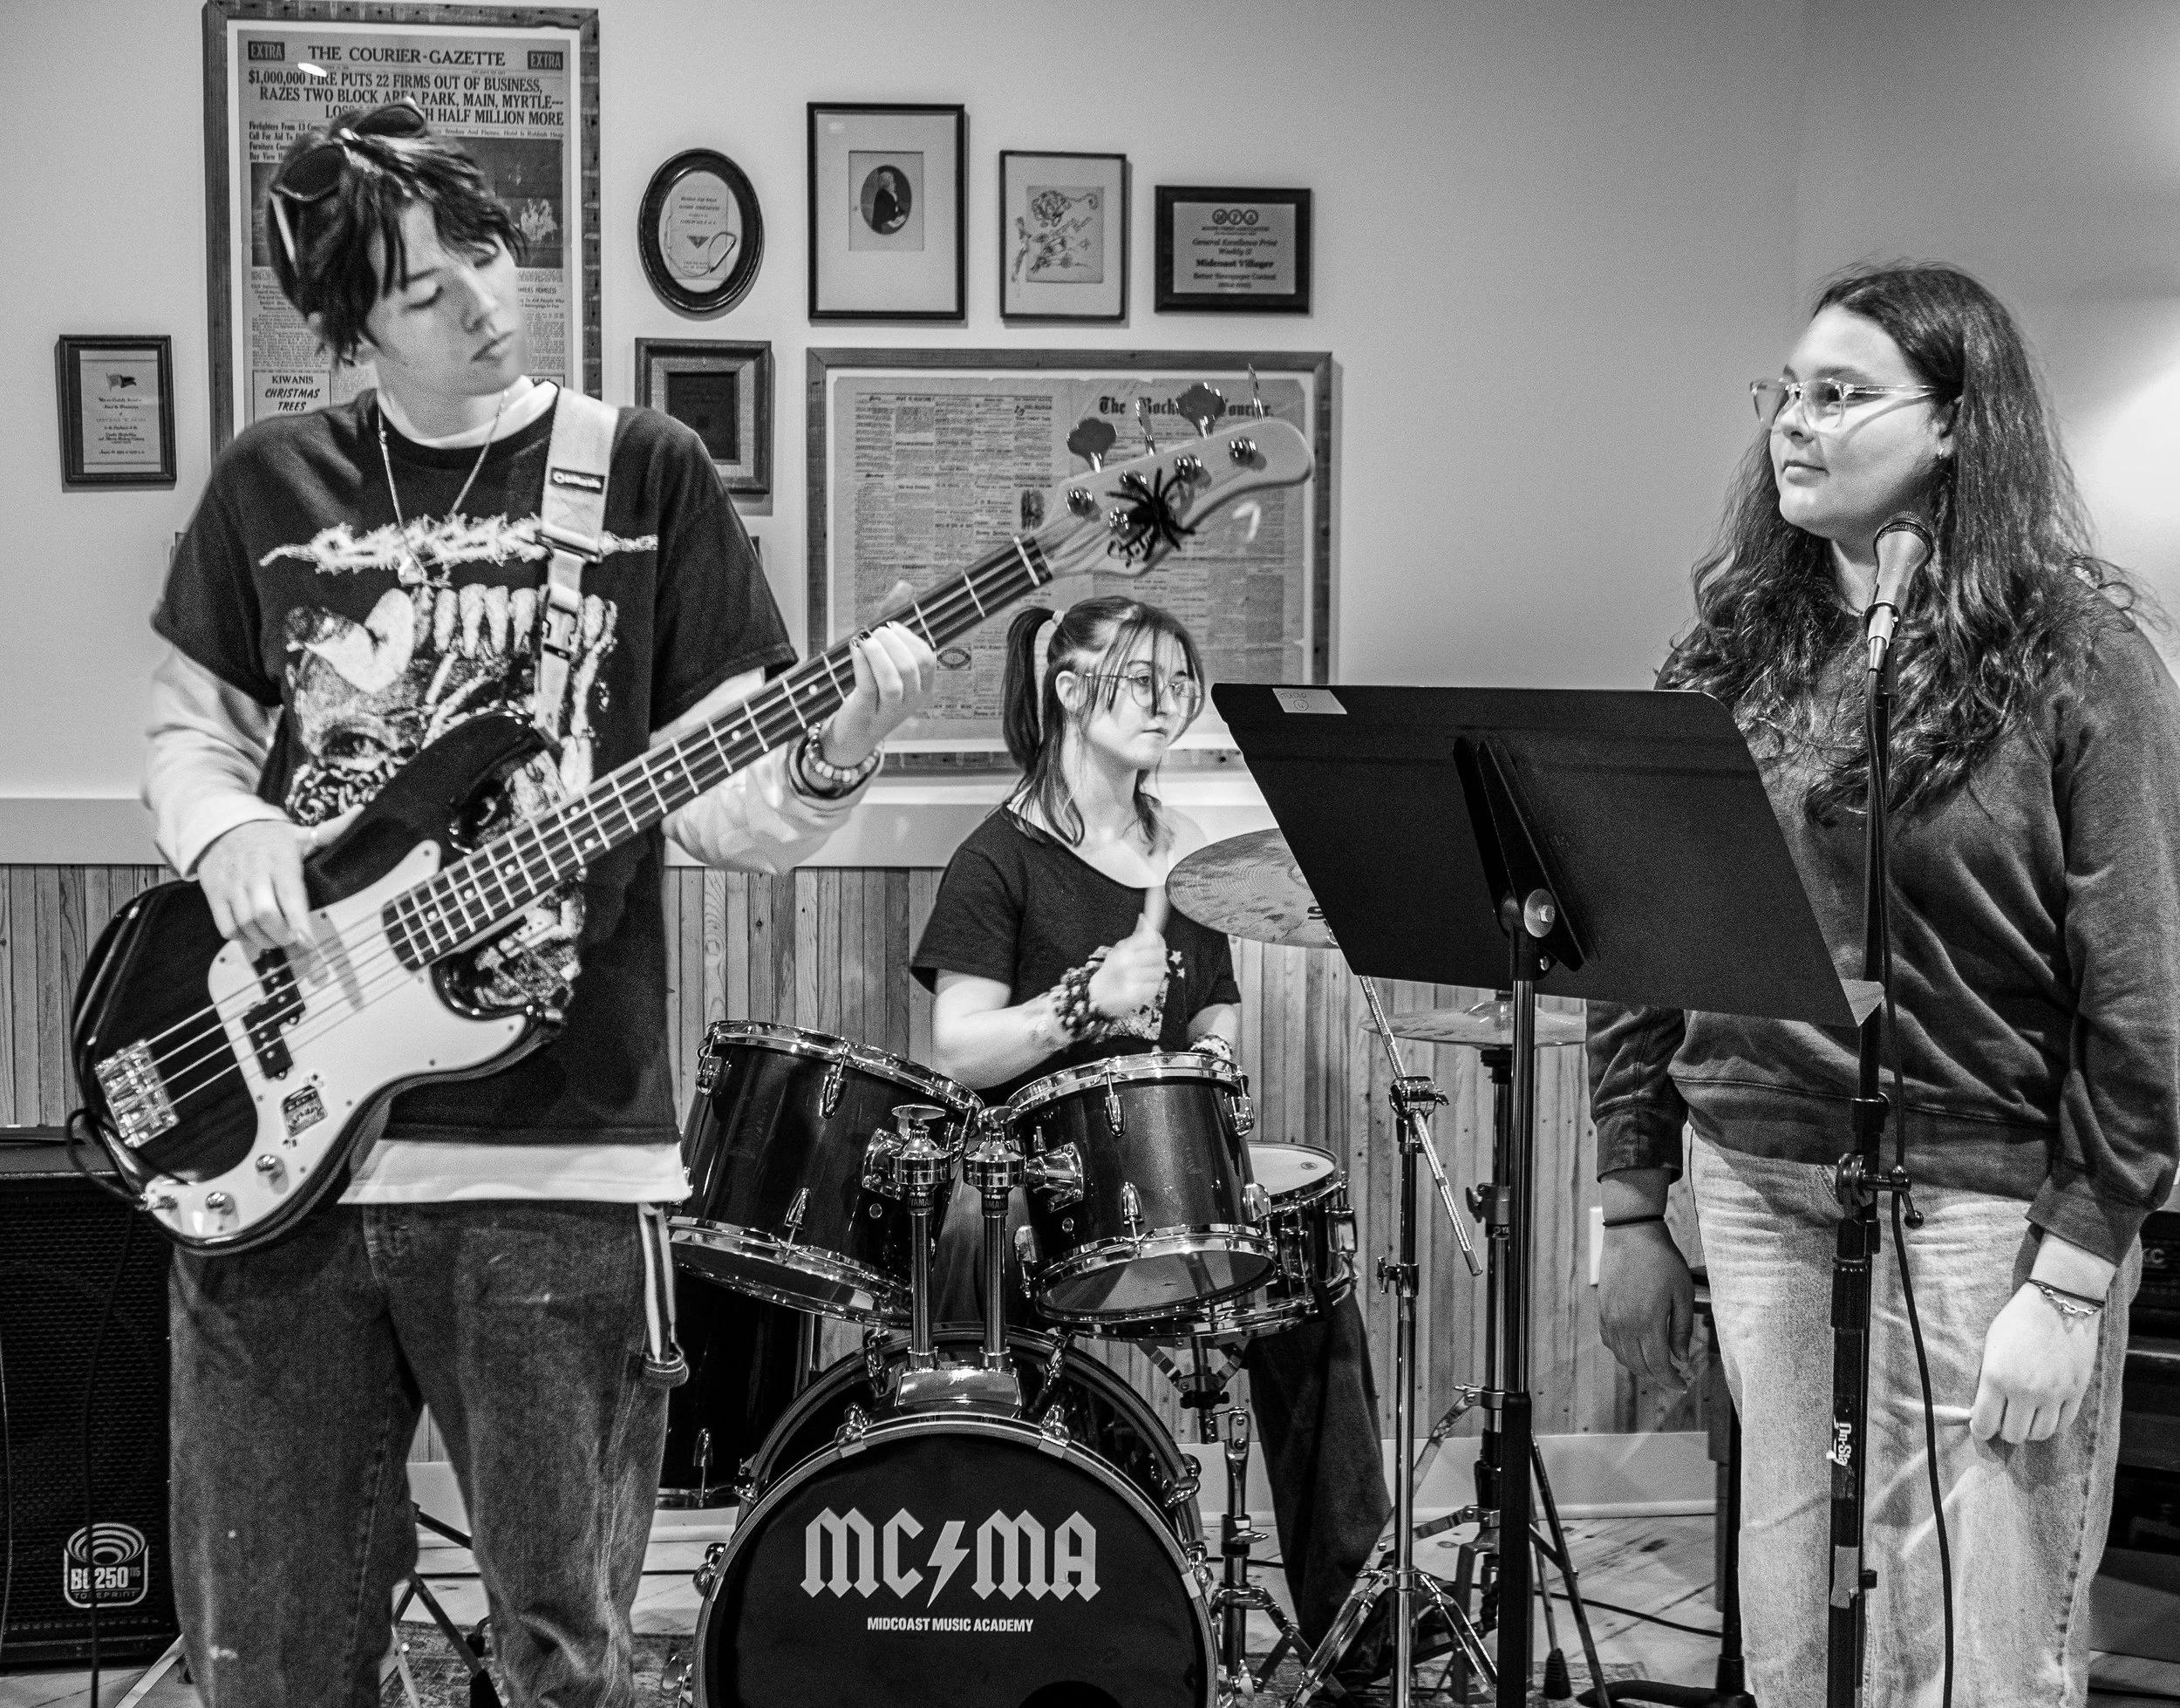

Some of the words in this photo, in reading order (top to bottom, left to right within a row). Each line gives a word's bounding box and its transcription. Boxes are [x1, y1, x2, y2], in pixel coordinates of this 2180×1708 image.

[250, 44, 283, 59] EXTRA
[307, 45, 342, 61] THE
[349, 47, 506, 66] COURIER-GAZETTE
[529, 52, 562, 68] EXTRA
[249, 70, 305, 86] $1,000,000
[309, 71, 337, 87] FIRE
[341, 72, 372, 87] PUTS
[376, 73, 390, 88] 22
[392, 74, 431, 89] FIRMS
[433, 75, 460, 90] OUT
[463, 76, 480, 91] OF
[484, 77, 542, 94] BUSINESS,
[260, 86, 300, 102] RAZES
[303, 87, 334, 103] TWO
[337, 89, 378, 104] BLOCK
[421, 91, 460, 106] PARK,
[463, 92, 499, 108] MAIN,
[438, 107, 471, 123] HALF
[474, 109, 525, 125] MILLION
[528, 111, 564, 126] MORE
[271, 375, 314, 385] KIWANIS
[264, 388, 320, 399] CHRISTMAS
[277, 401, 307, 412] TREES
[1099, 396, 1127, 415] The
[74, 1591, 135, 1600] TOEPRINT
[867, 1616, 930, 1632] MIDCOAST
[932, 1616, 971, 1632] MUSIC
[972, 1617, 1034, 1633] ACADEMY
